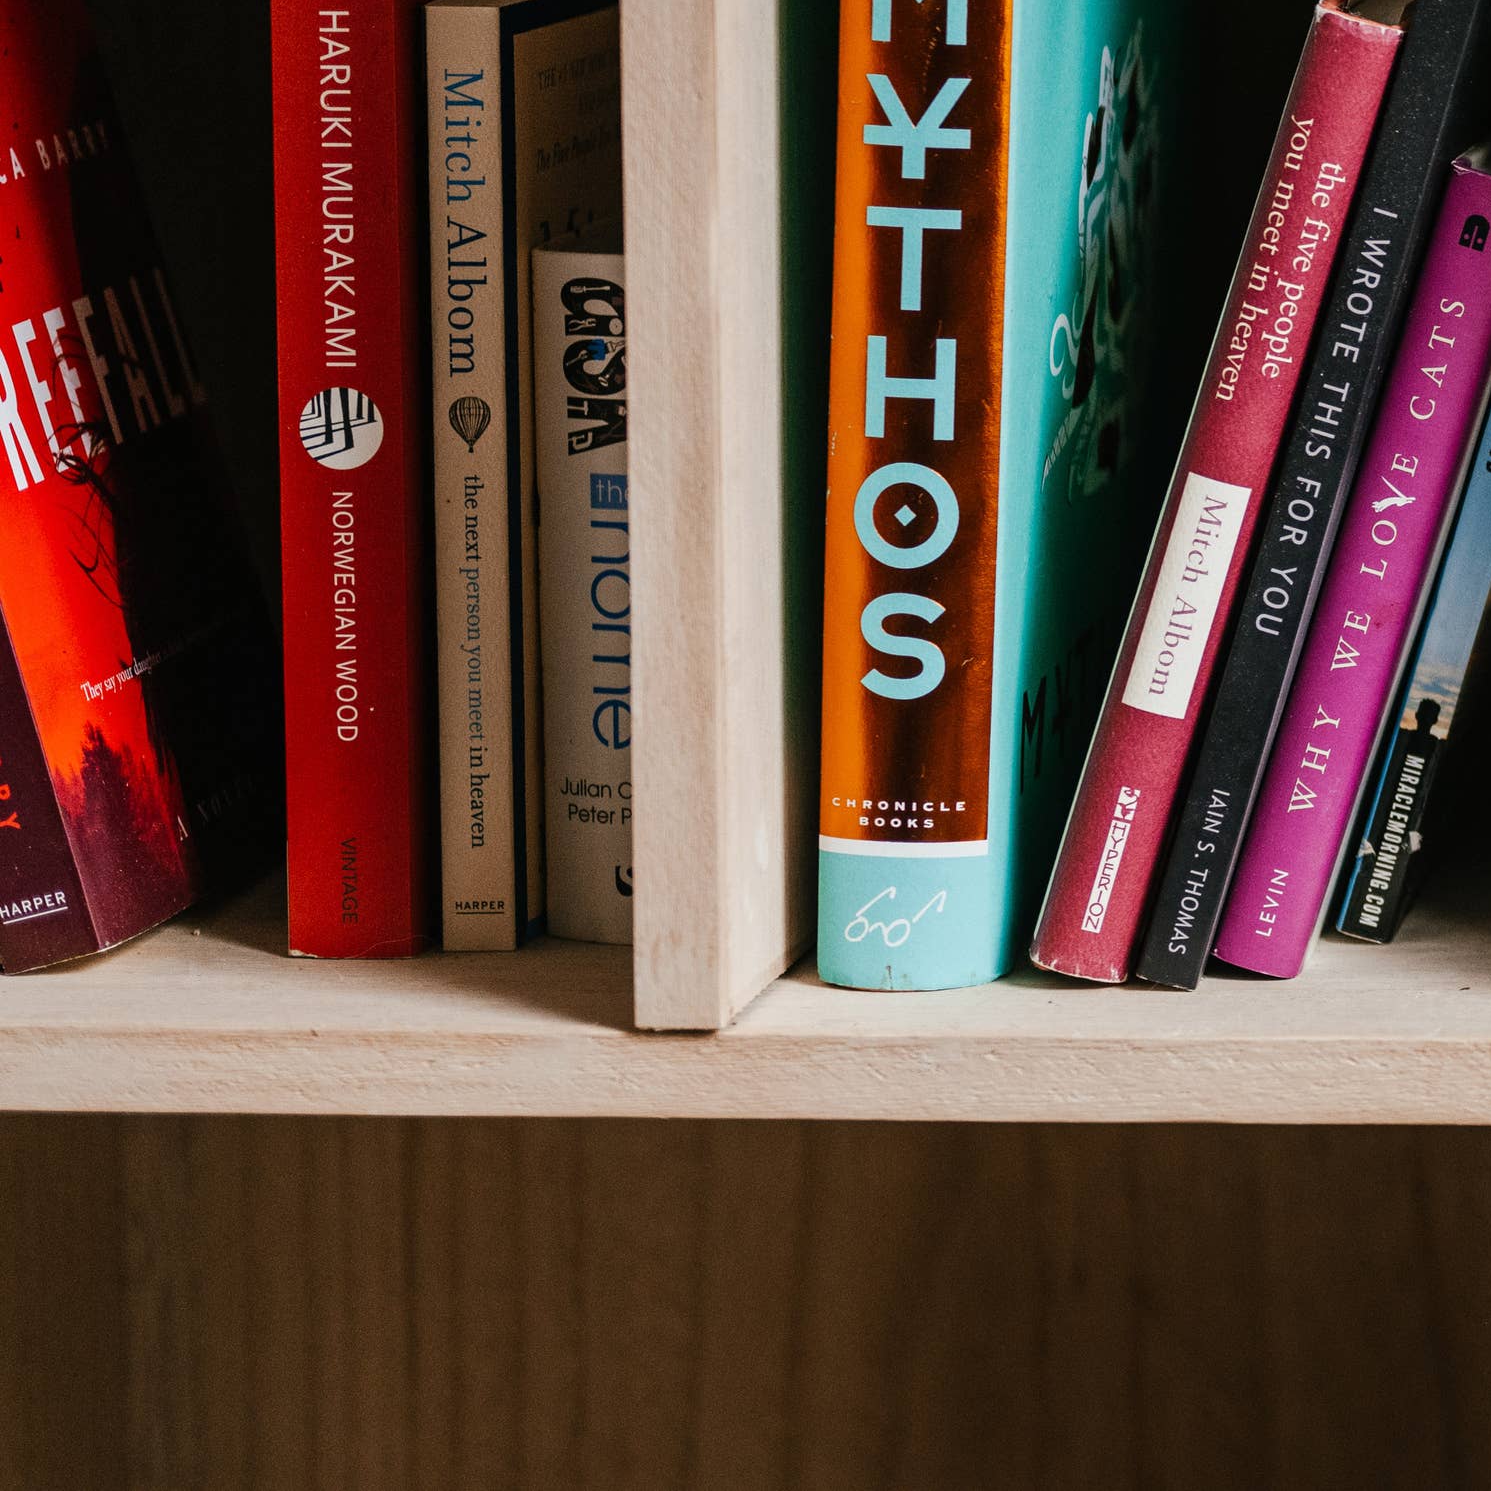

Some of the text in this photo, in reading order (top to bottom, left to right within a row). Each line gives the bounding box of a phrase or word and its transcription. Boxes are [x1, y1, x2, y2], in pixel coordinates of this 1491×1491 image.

[318, 10, 357, 368] HARUKI MURAKAMI
[444, 68, 488, 379] Mitch Albom
[1215, 114, 1314, 402] you meet in heaven
[1261, 161, 1346, 380] the five people
[1255, 207, 1399, 637] I WROTE THIS FOR YOU
[332, 491, 359, 743] NORWEGIAN WOOD
[1148, 494, 1229, 696] Mitch Albom
[1287, 297, 1466, 814] WHY WE LOVE CATS
[80, 680, 104, 701] They
[103, 675, 118, 693] say
[116, 666, 134, 690] your
[459, 474, 490, 849] the next person you meet in heaven
[560, 777, 612, 800] Julian
[568, 804, 616, 825] Peter
[832, 796, 967, 812] CHRONICLE
[858, 816, 935, 829] BOOKS
[1168, 788, 1231, 955] IAIN S. THOMAS
[1358, 753, 1426, 930] MIRACLEMORNING.COM
[0, 891, 67, 920] HARPER
[340, 837, 360, 925] VINTAGE
[455, 901, 505, 911] HARPER
[1084, 822, 1128, 930] HYPERION
[1255, 868, 1290, 938] LEVIN
